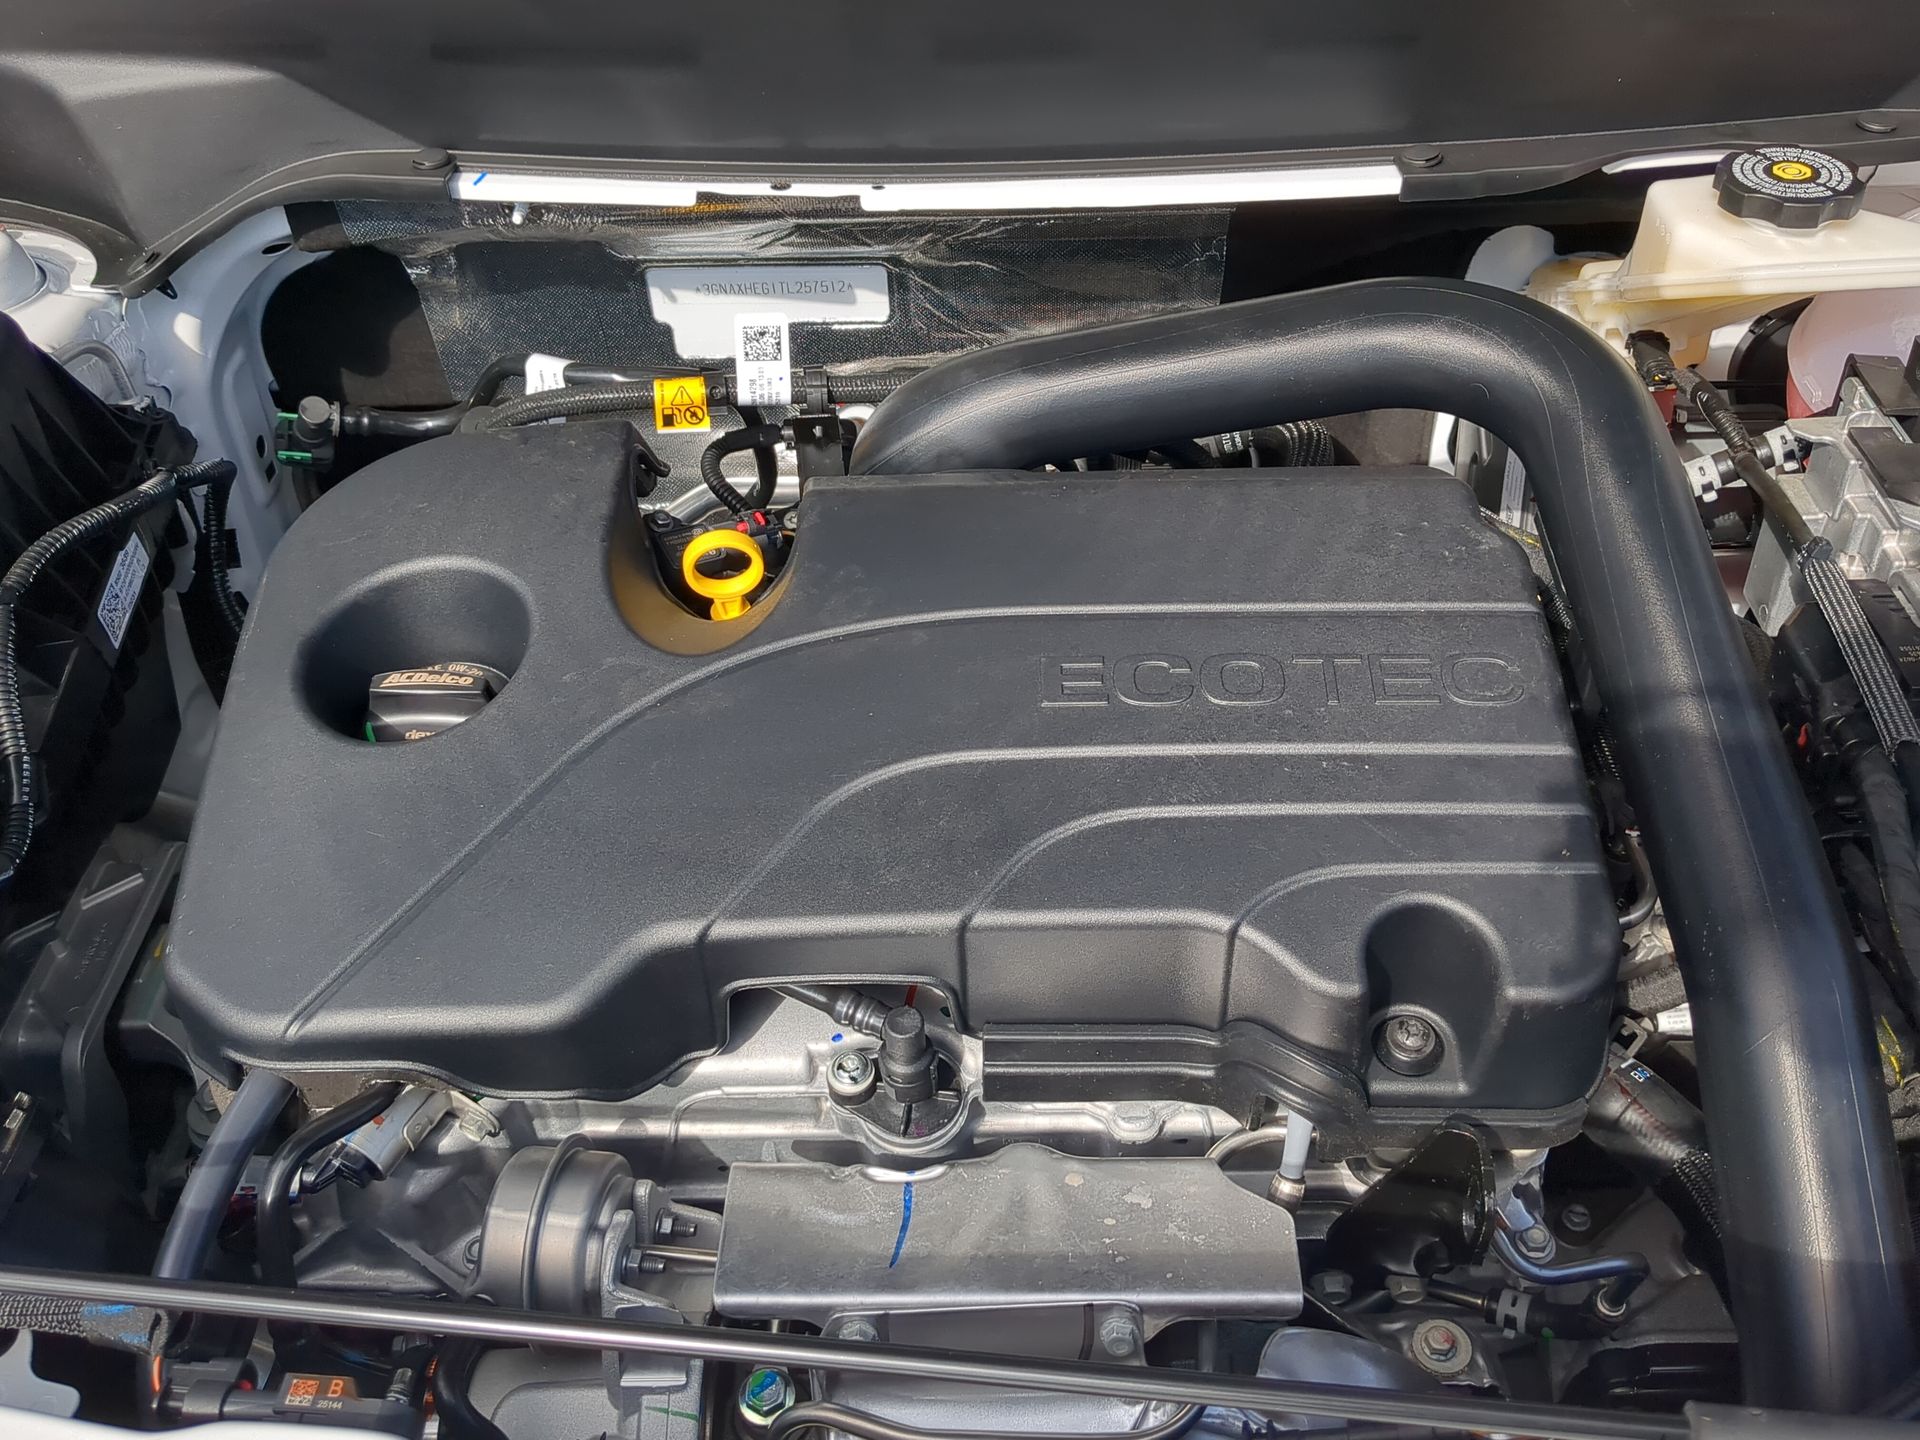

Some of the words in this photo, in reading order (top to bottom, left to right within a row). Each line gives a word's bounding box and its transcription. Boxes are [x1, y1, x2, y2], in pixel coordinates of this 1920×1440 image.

[383, 672, 475, 685] ACDelco
[1040, 653, 1525, 708] ECOTEC
[327, 1379, 344, 1397] B
